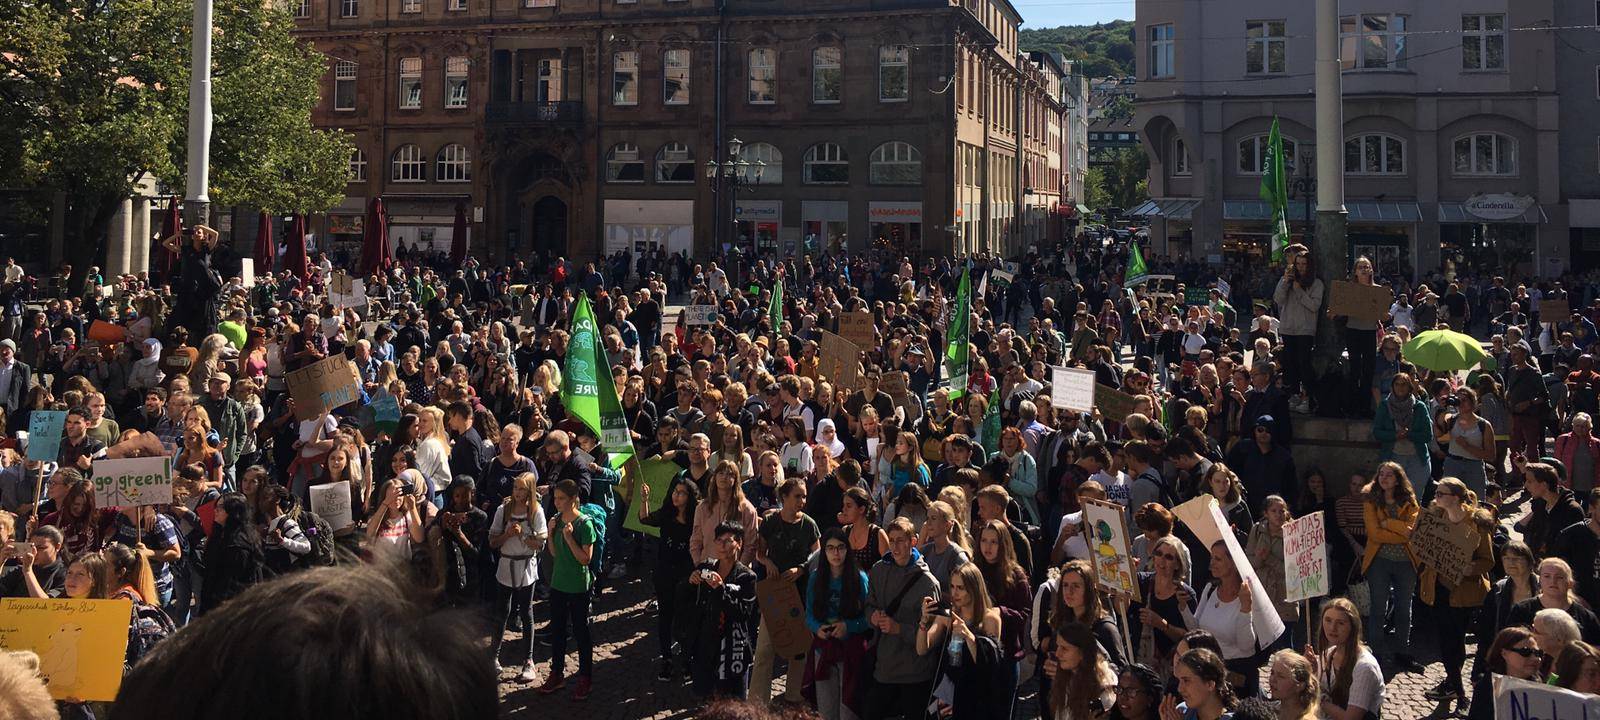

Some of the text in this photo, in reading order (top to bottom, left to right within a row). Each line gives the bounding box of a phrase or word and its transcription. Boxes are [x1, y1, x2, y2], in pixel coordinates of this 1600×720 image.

[95, 458, 171, 491] go green!
[1302, 514, 1321, 533] DAS
